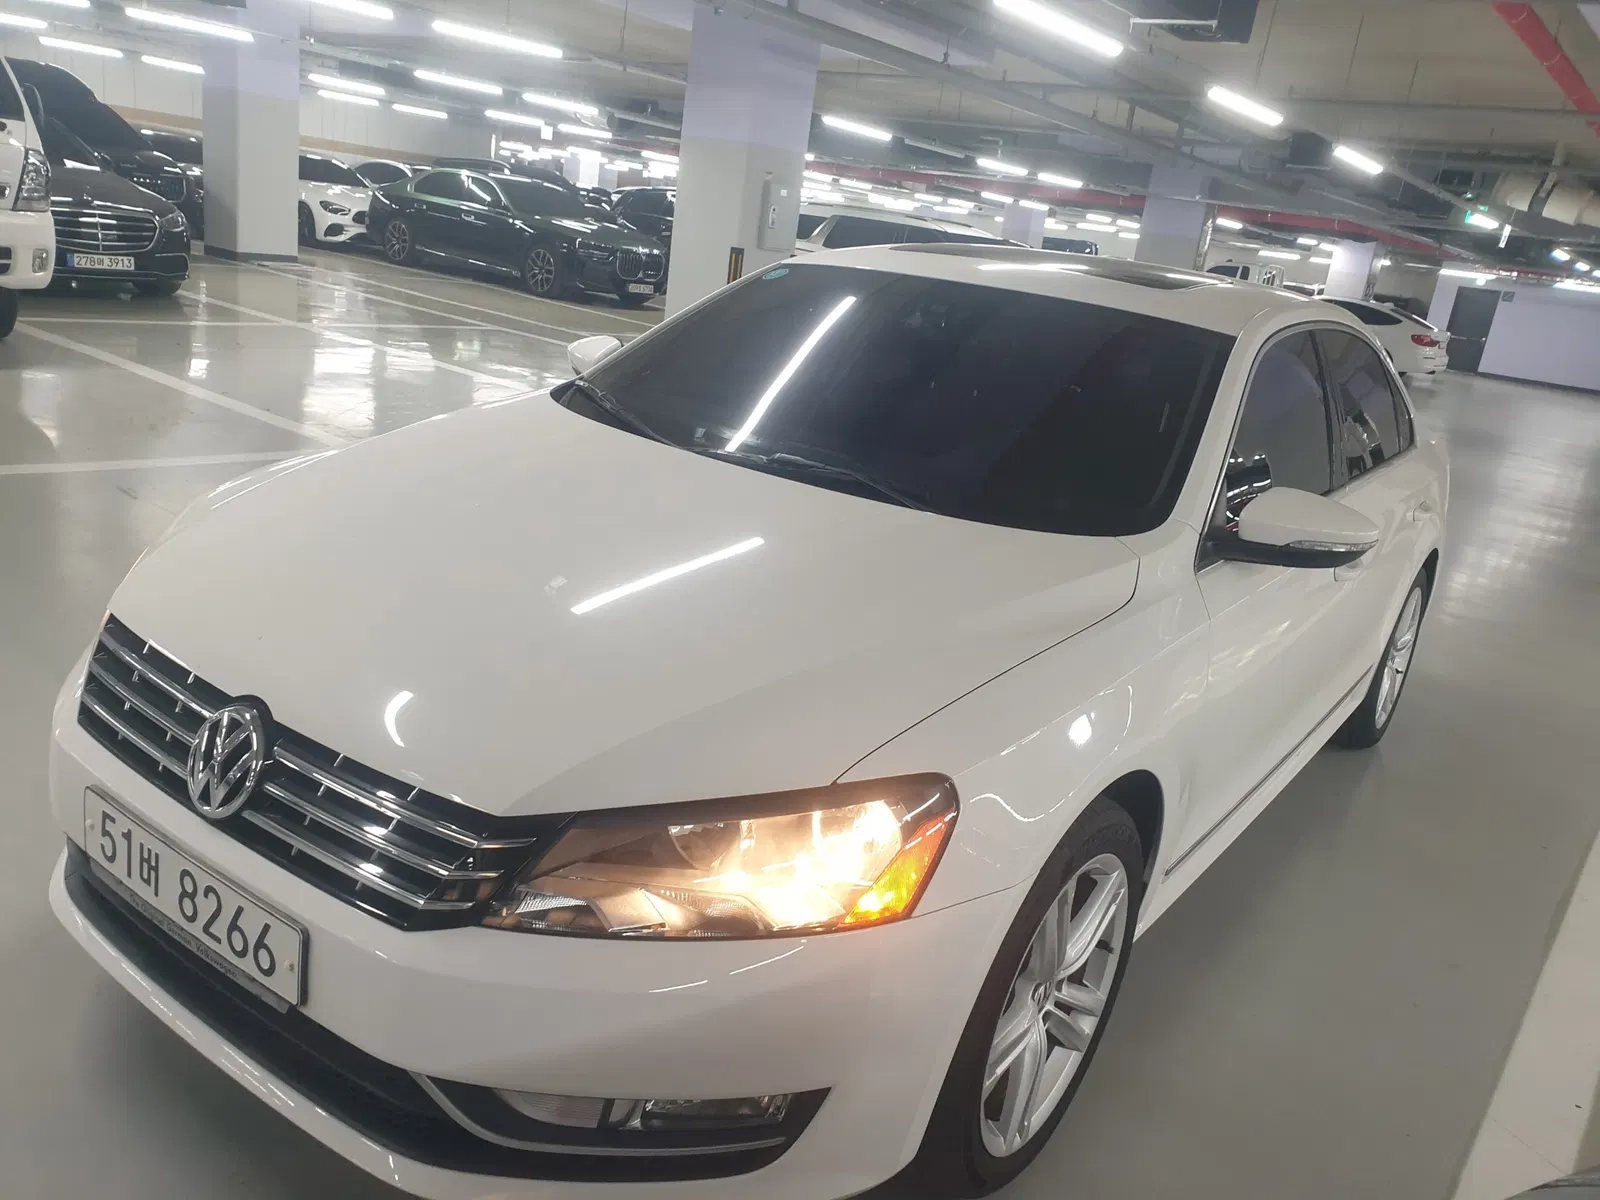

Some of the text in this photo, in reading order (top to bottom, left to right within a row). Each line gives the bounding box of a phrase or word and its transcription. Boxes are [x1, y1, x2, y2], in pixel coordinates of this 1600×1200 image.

[107, 257, 133, 269] 3913
[100, 809, 276, 978] 51버 8266
